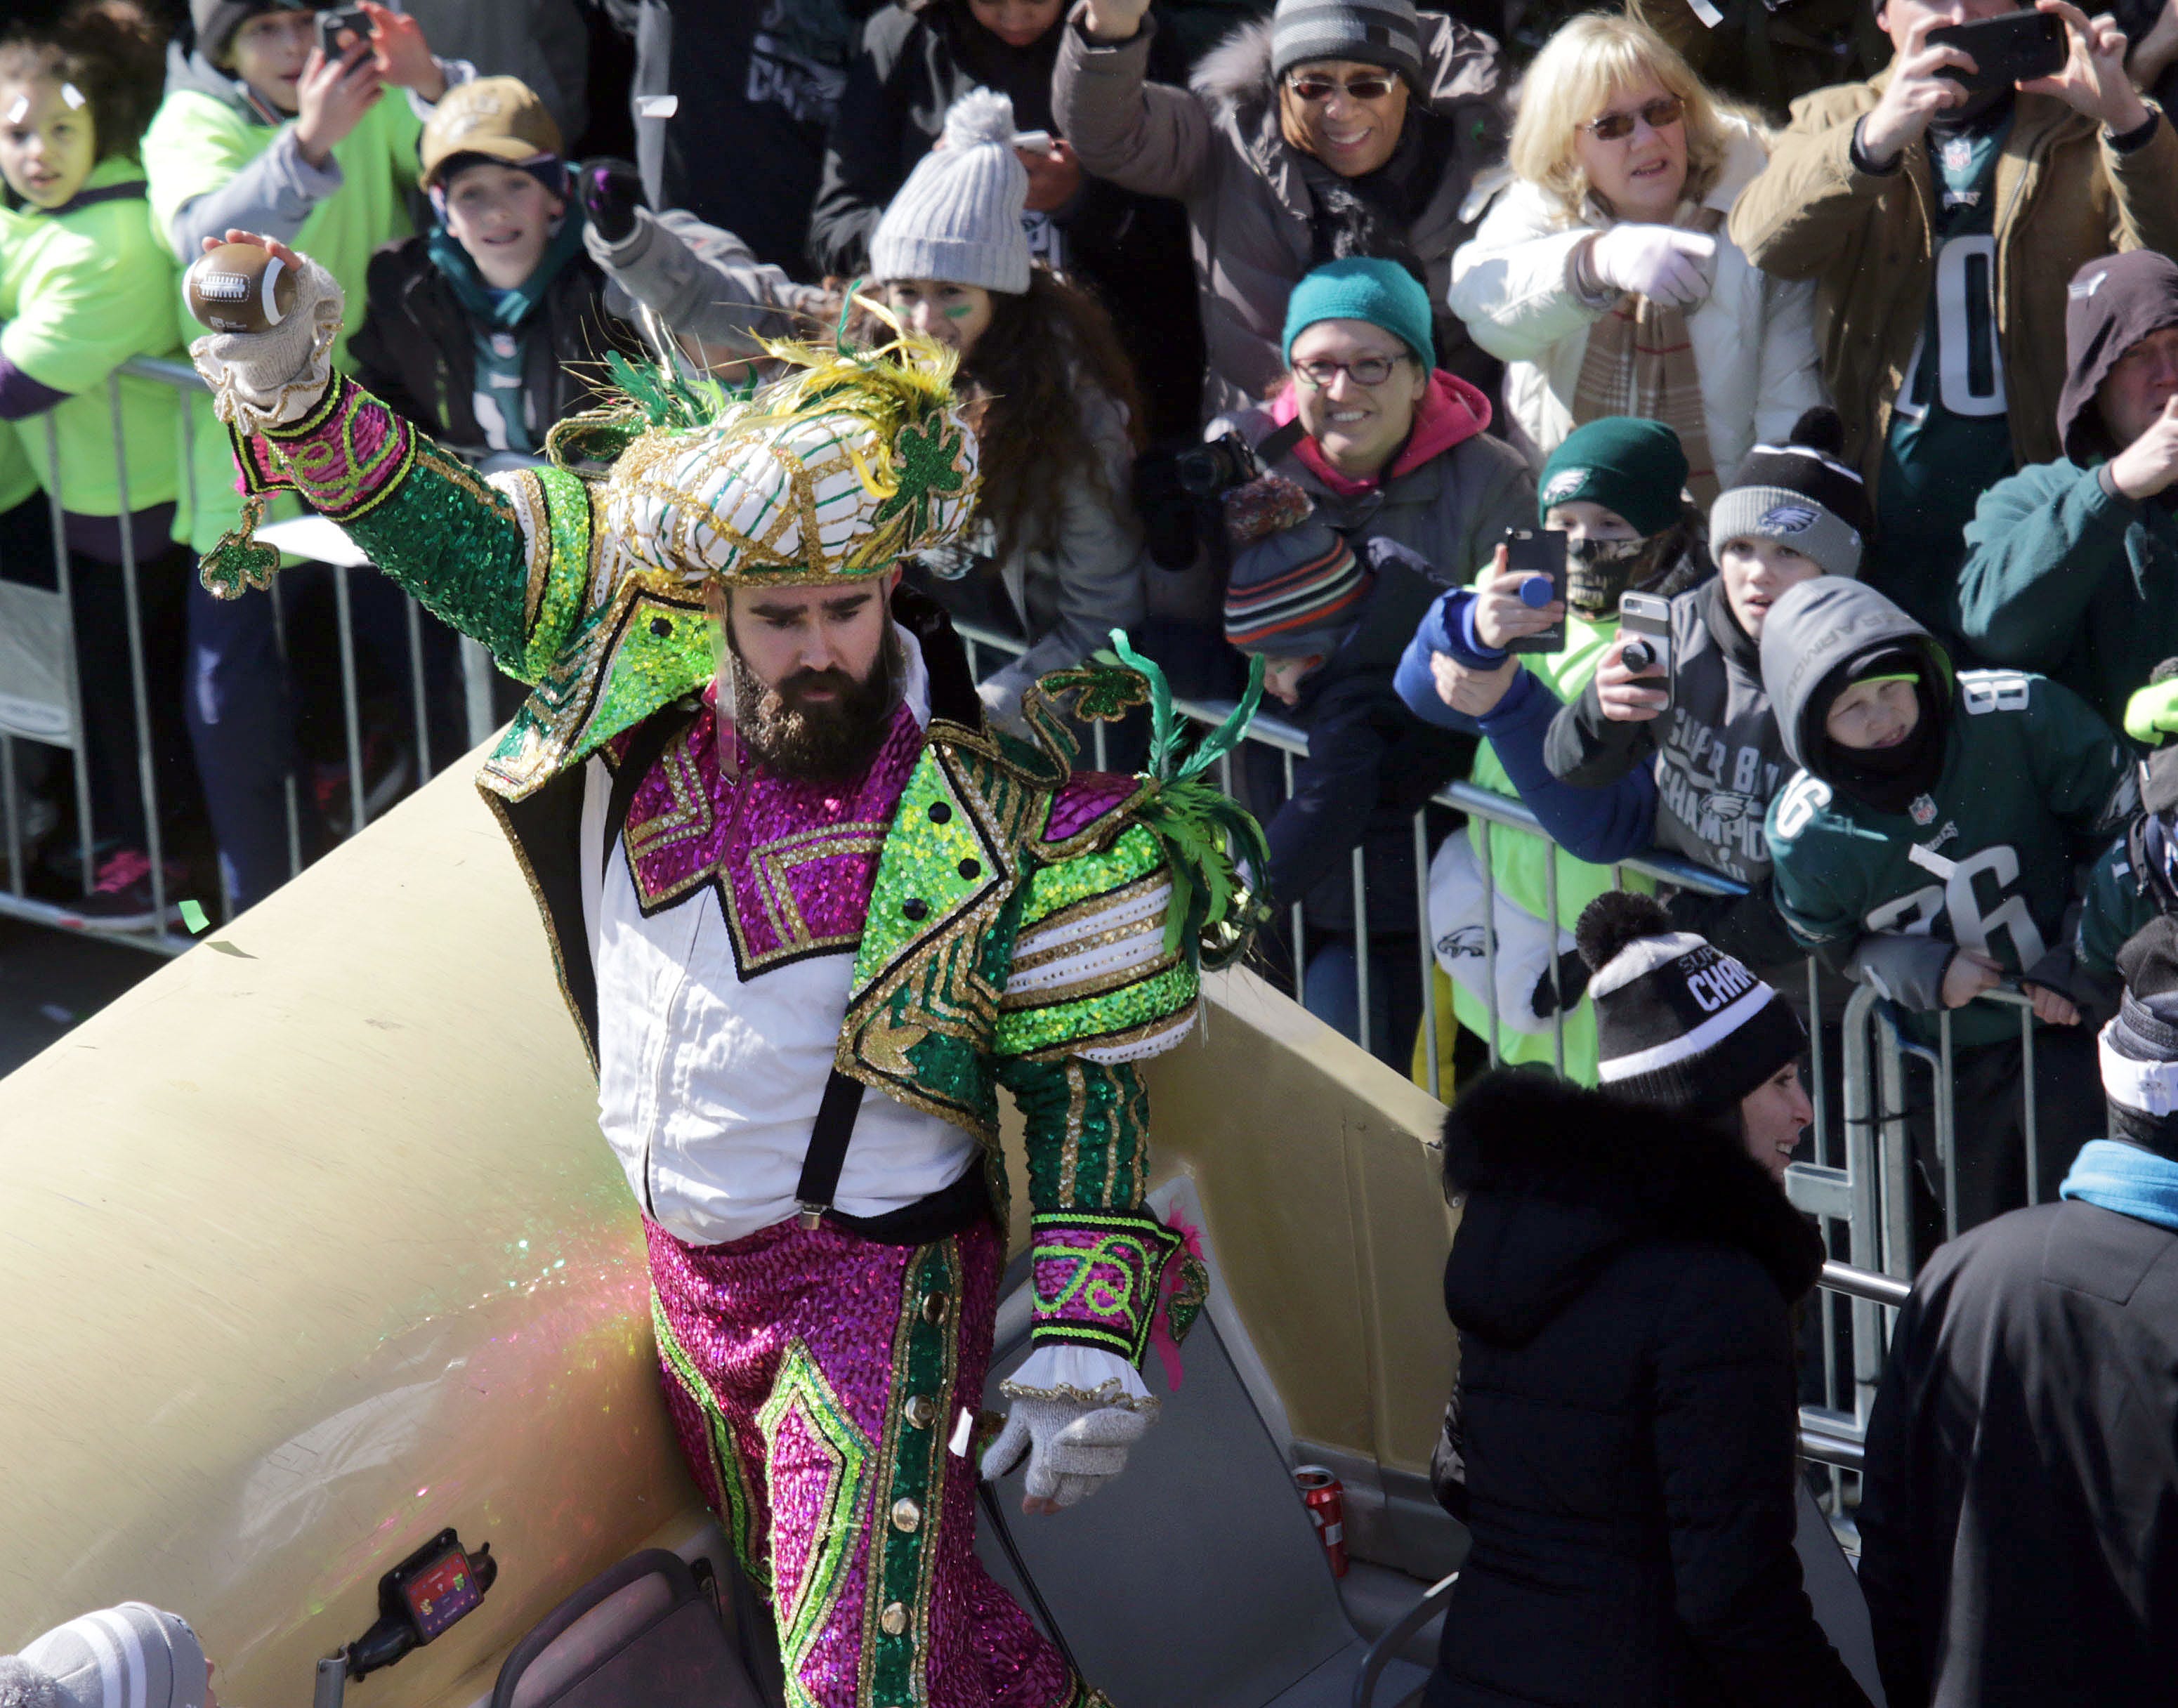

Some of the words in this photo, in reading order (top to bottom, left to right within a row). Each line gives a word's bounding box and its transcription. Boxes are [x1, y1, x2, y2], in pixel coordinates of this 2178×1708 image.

[1956, 669, 2030, 715] 8
[1667, 708, 1728, 784] SUPR
[1777, 767, 1833, 839] 6
